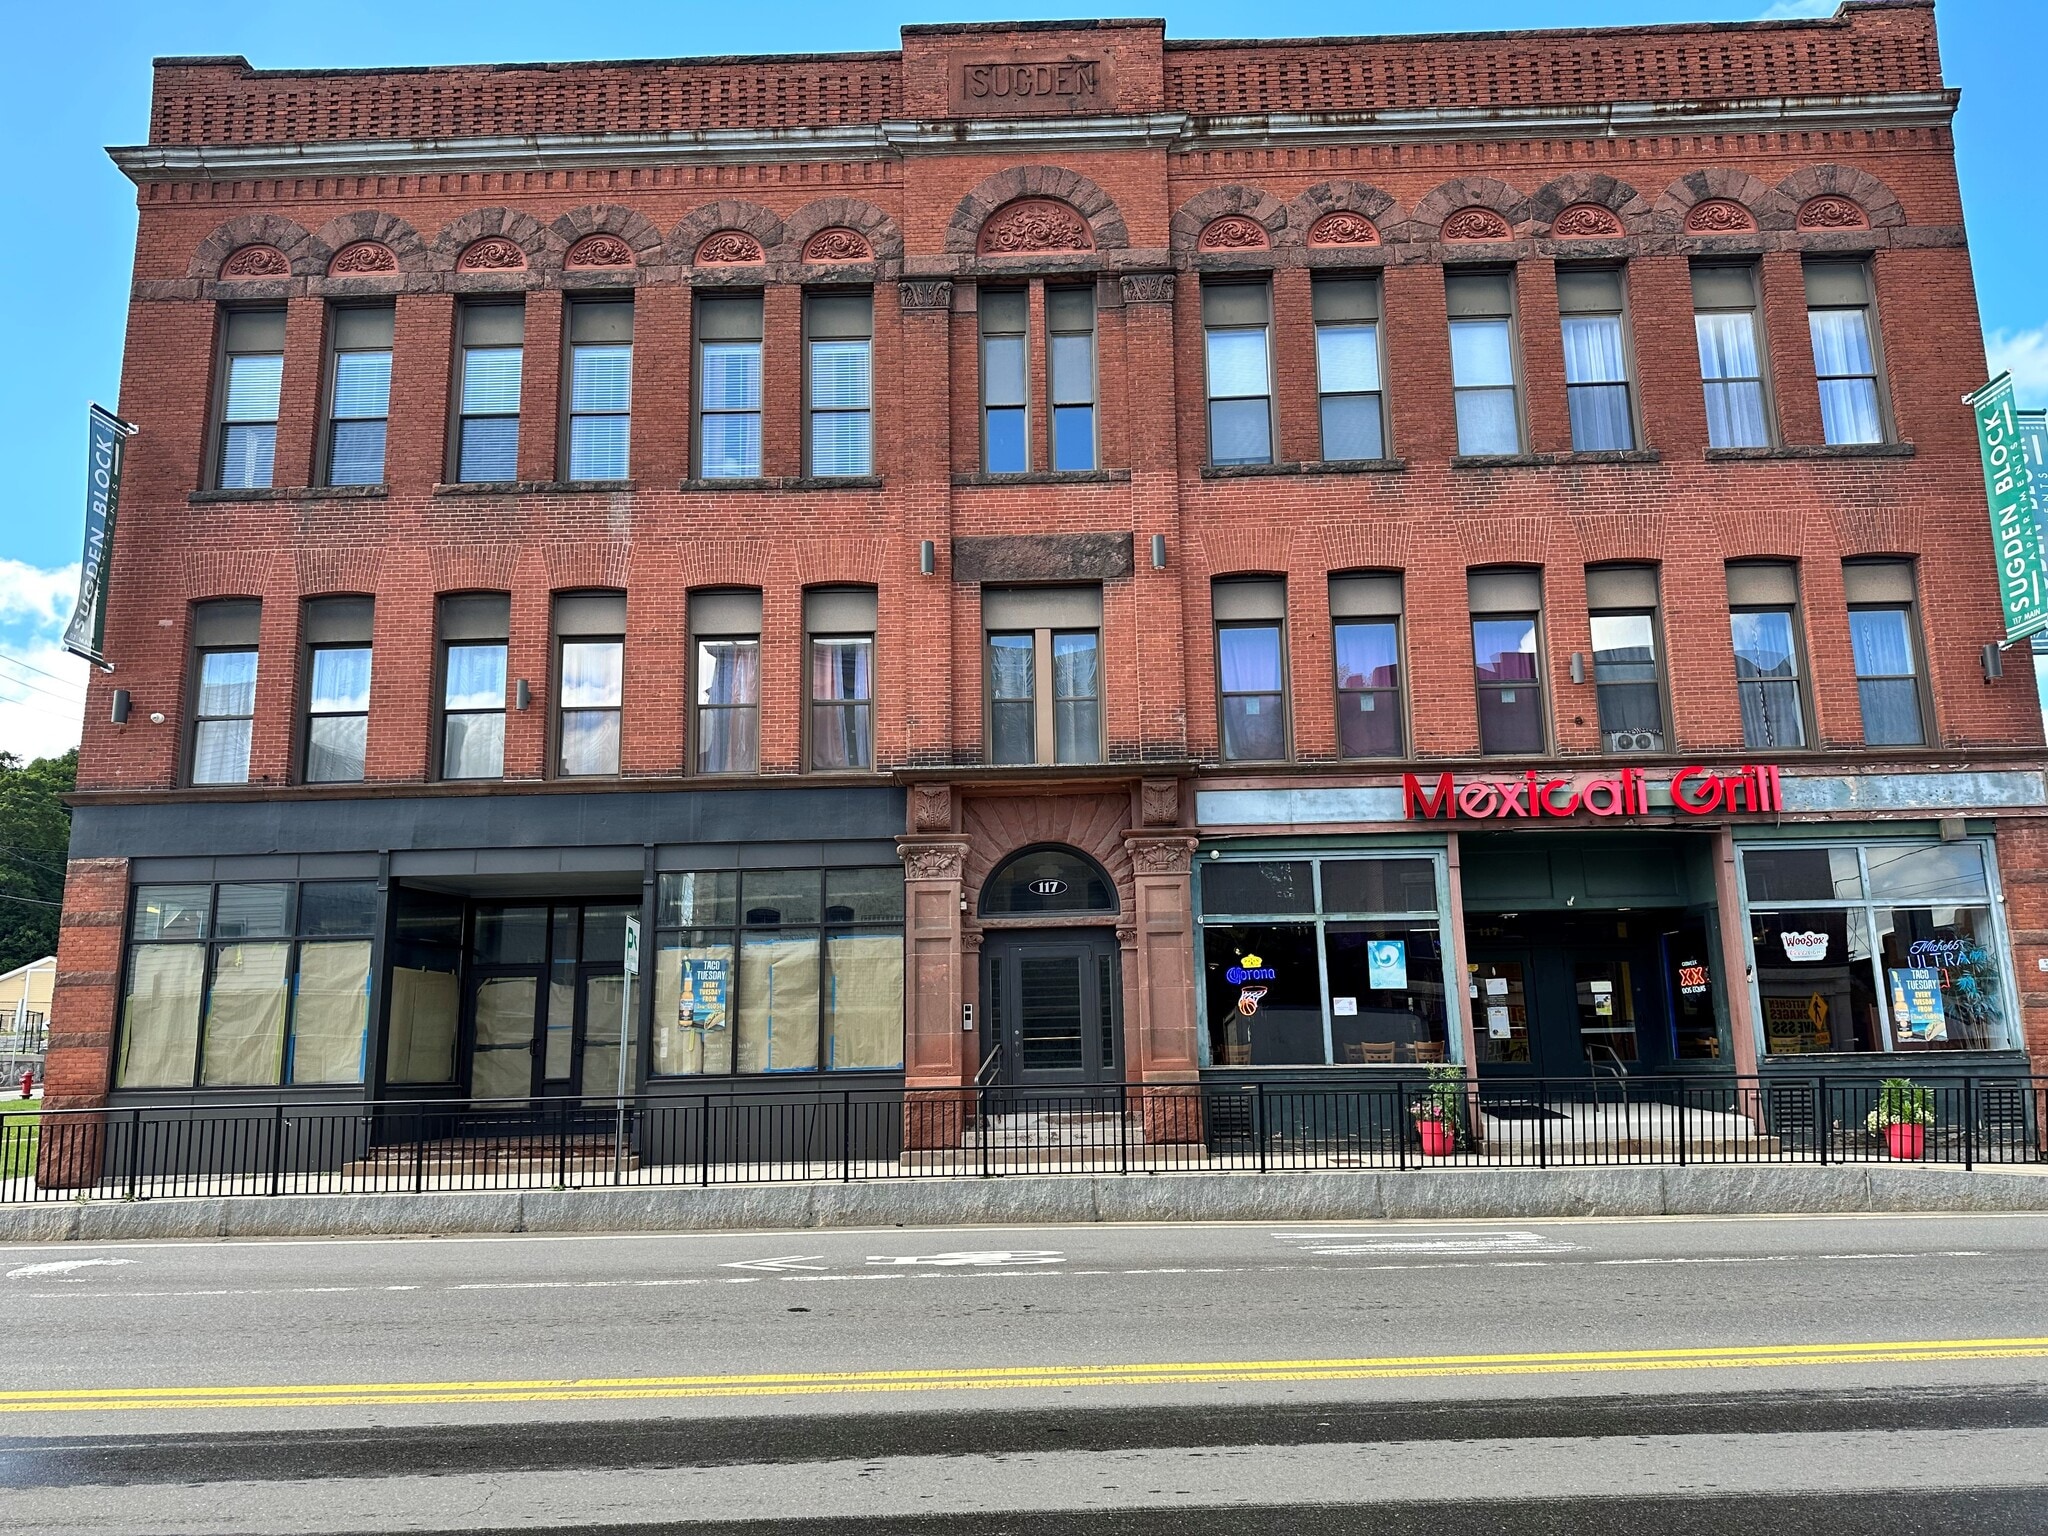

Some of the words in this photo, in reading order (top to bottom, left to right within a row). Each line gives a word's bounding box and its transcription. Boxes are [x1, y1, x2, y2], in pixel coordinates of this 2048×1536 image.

[971, 63, 1095, 98] SUGDEN
[1984, 409, 2014, 495] BLOCK
[2010, 441, 2037, 560] APARTMENTS
[74, 526, 105, 633] SUGDEN
[92, 433, 112, 518] BLOCK
[1998, 503, 2029, 613] SUGDEN
[2012, 615, 2022, 625] 117
[2024, 608, 2041, 620] MAIN
[1402, 768, 1646, 819] Mexicali
[1670, 765, 1783, 815] Grill
[1038, 881, 1058, 893] 117
[1785, 934, 1825, 947] WooSox
[704, 961, 720, 971] TACO
[1907, 951, 1971, 969] ULTRA
[697, 970, 726, 980] TUESDAY
[1226, 966, 1276, 984] Corona
[1911, 969, 1930, 980] TACO
[1906, 980, 1937, 990] TUESDAY
